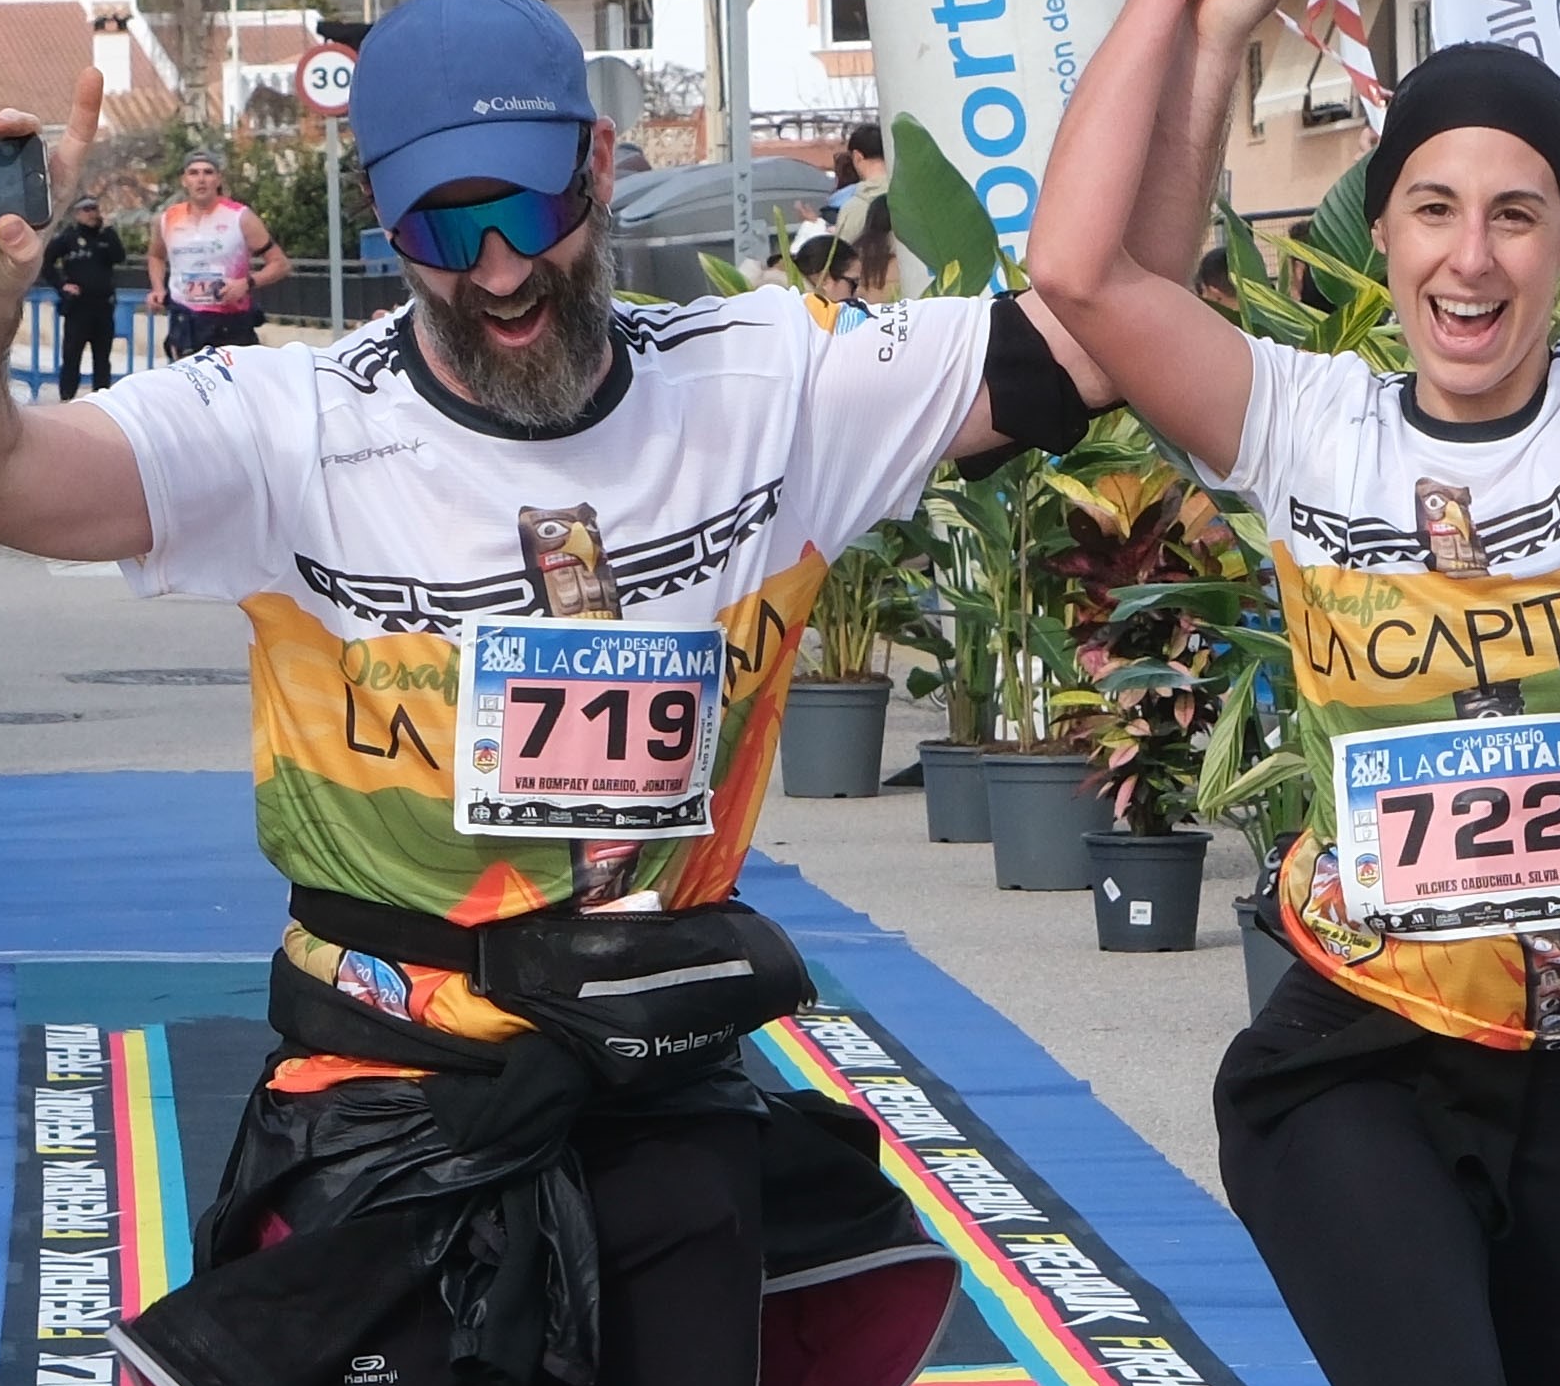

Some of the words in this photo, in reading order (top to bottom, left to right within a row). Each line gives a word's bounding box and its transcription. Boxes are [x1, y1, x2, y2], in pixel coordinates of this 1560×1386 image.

[312, 67, 351, 90] 30
[491, 95, 557, 113] Columbia
[624, 636, 677, 652] DESAFÍO
[1304, 610, 1356, 681] LA
[481, 657, 526, 672] 2026
[345, 683, 440, 769] LA
[511, 687, 696, 761] 719
[1486, 728, 1544, 747] DESAFÍO
[515, 776, 535, 790] VAN
[1351, 770, 1391, 788] 2026
[1416, 879, 1458, 896] VILCHES
[1528, 869, 1559, 885] SILVIA
[357, 965, 370, 982] 20
[381, 988, 399, 1004] 26
[655, 1024, 735, 1056] Kalenji
[35, 1085, 112, 1154] FIREHAWK
[42, 1160, 125, 1238] FIREHAWK
[848, 1076, 967, 1142] FIREHAWK
[916, 1148, 1050, 1225] FIREHAWK
[997, 1234, 1150, 1328] FIREHAWK
[38, 1245, 124, 1339] FIREHAWK
[344, 1369, 399, 1386] Kalenji
